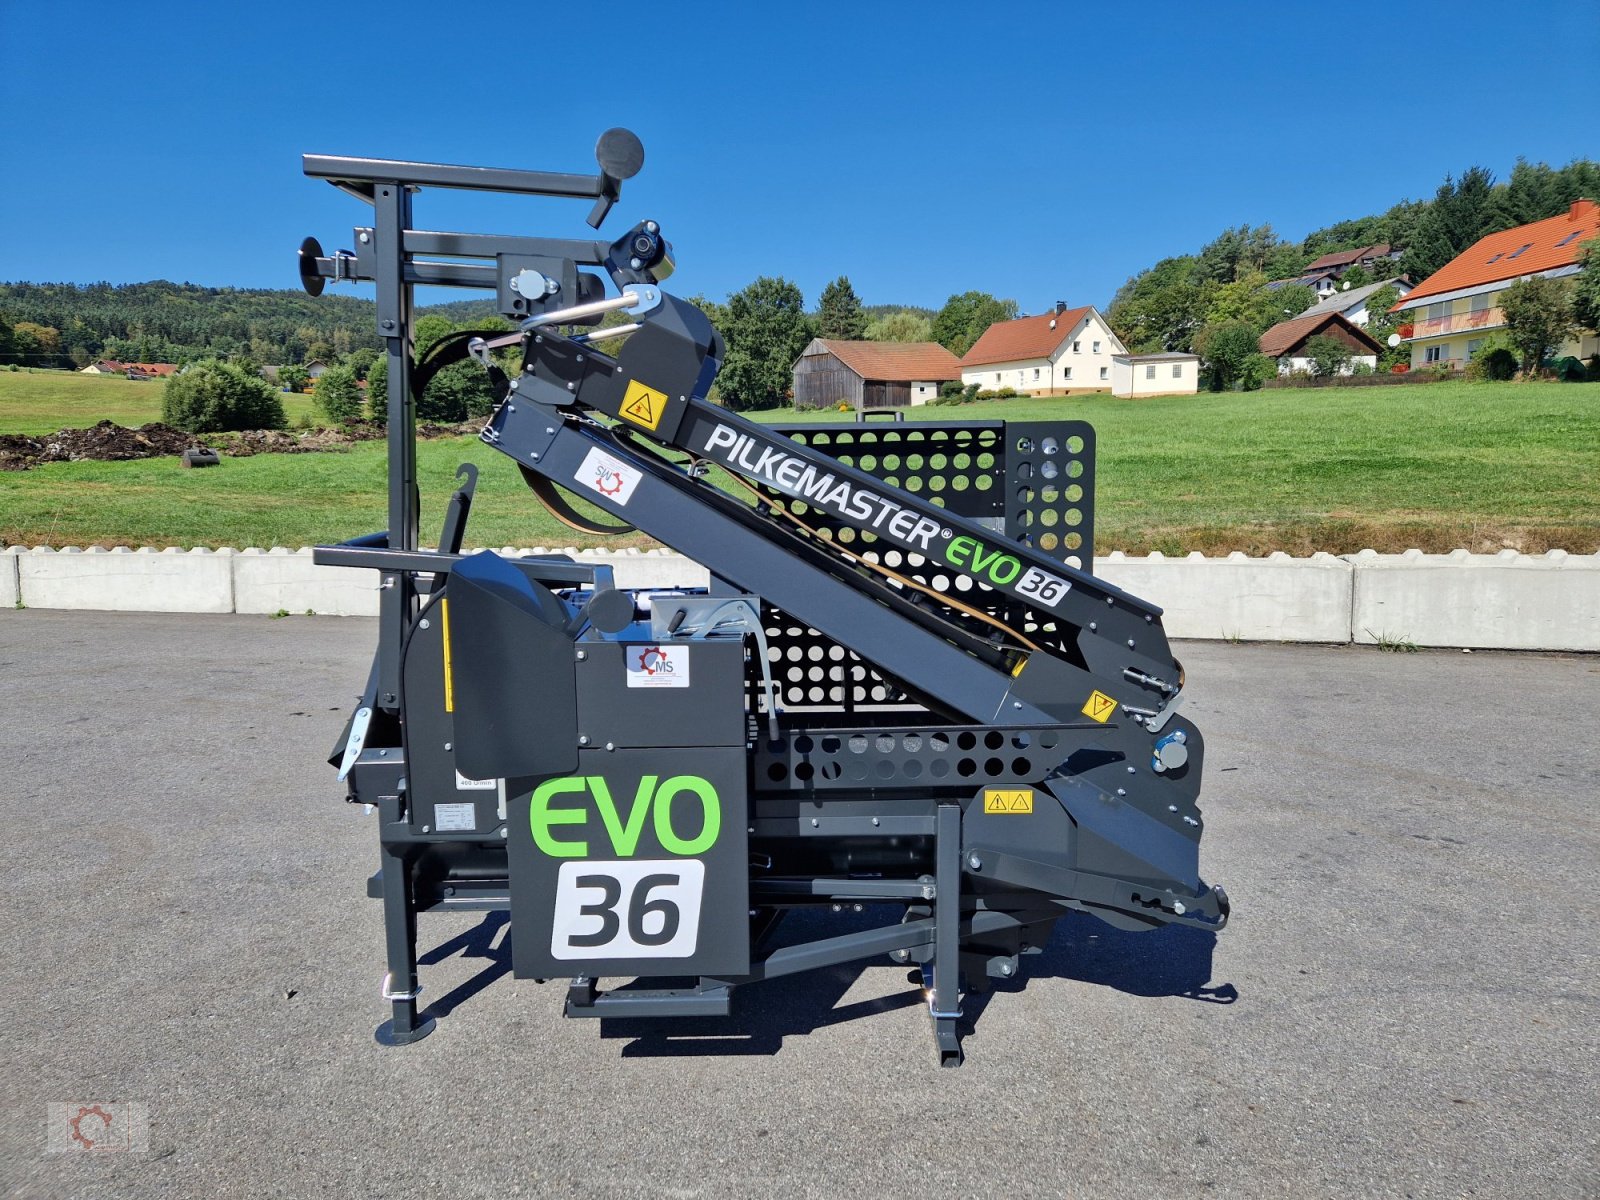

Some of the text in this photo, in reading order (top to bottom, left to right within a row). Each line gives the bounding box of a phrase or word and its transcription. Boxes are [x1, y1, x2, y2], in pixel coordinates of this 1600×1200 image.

[945, 535, 1021, 584] EVO
[1021, 571, 1063, 600] 36
[655, 661, 674, 673] MS
[529, 775, 721, 857] EVO
[567, 873, 680, 947] 36
